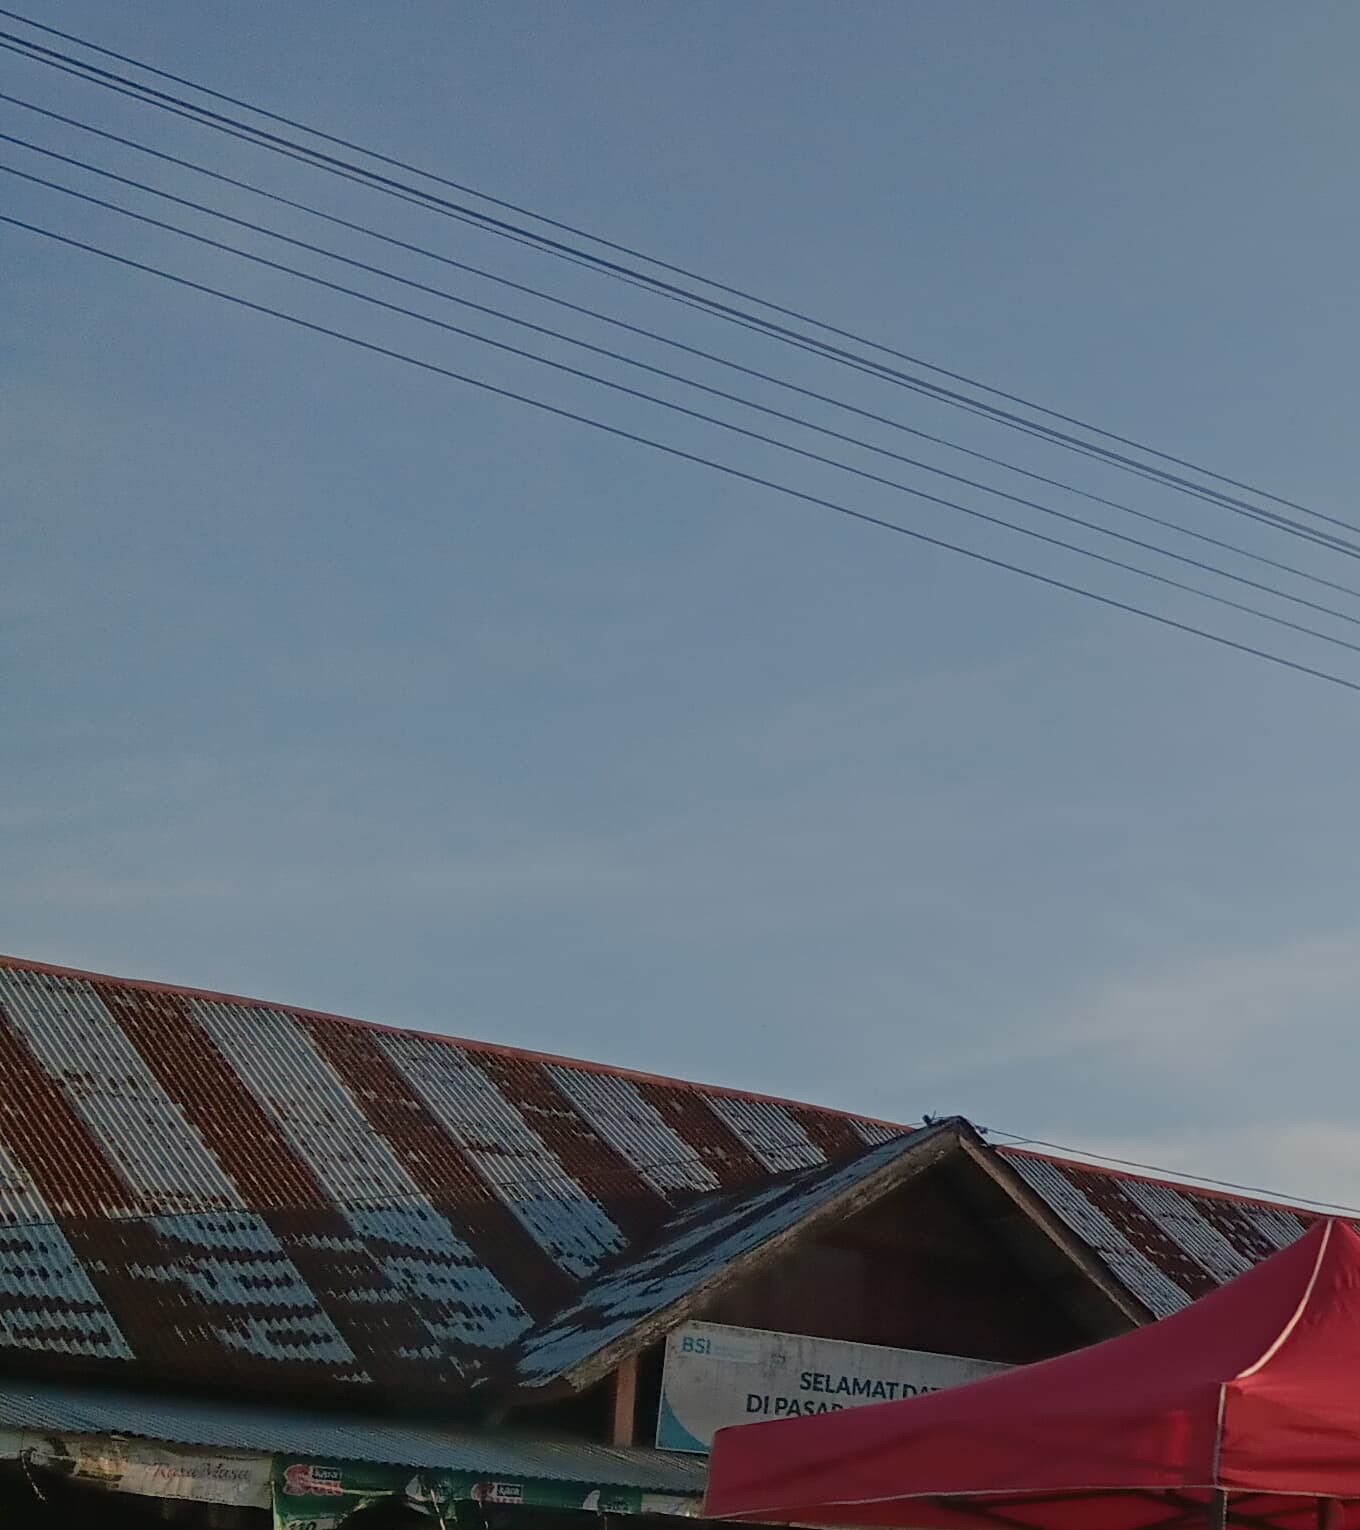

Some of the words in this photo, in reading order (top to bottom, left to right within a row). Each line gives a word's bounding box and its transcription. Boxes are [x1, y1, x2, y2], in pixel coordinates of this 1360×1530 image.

[682, 1335, 711, 1355] BSI
[800, 1371, 899, 1400] SELAMAT
[746, 1393, 768, 1415] DI
